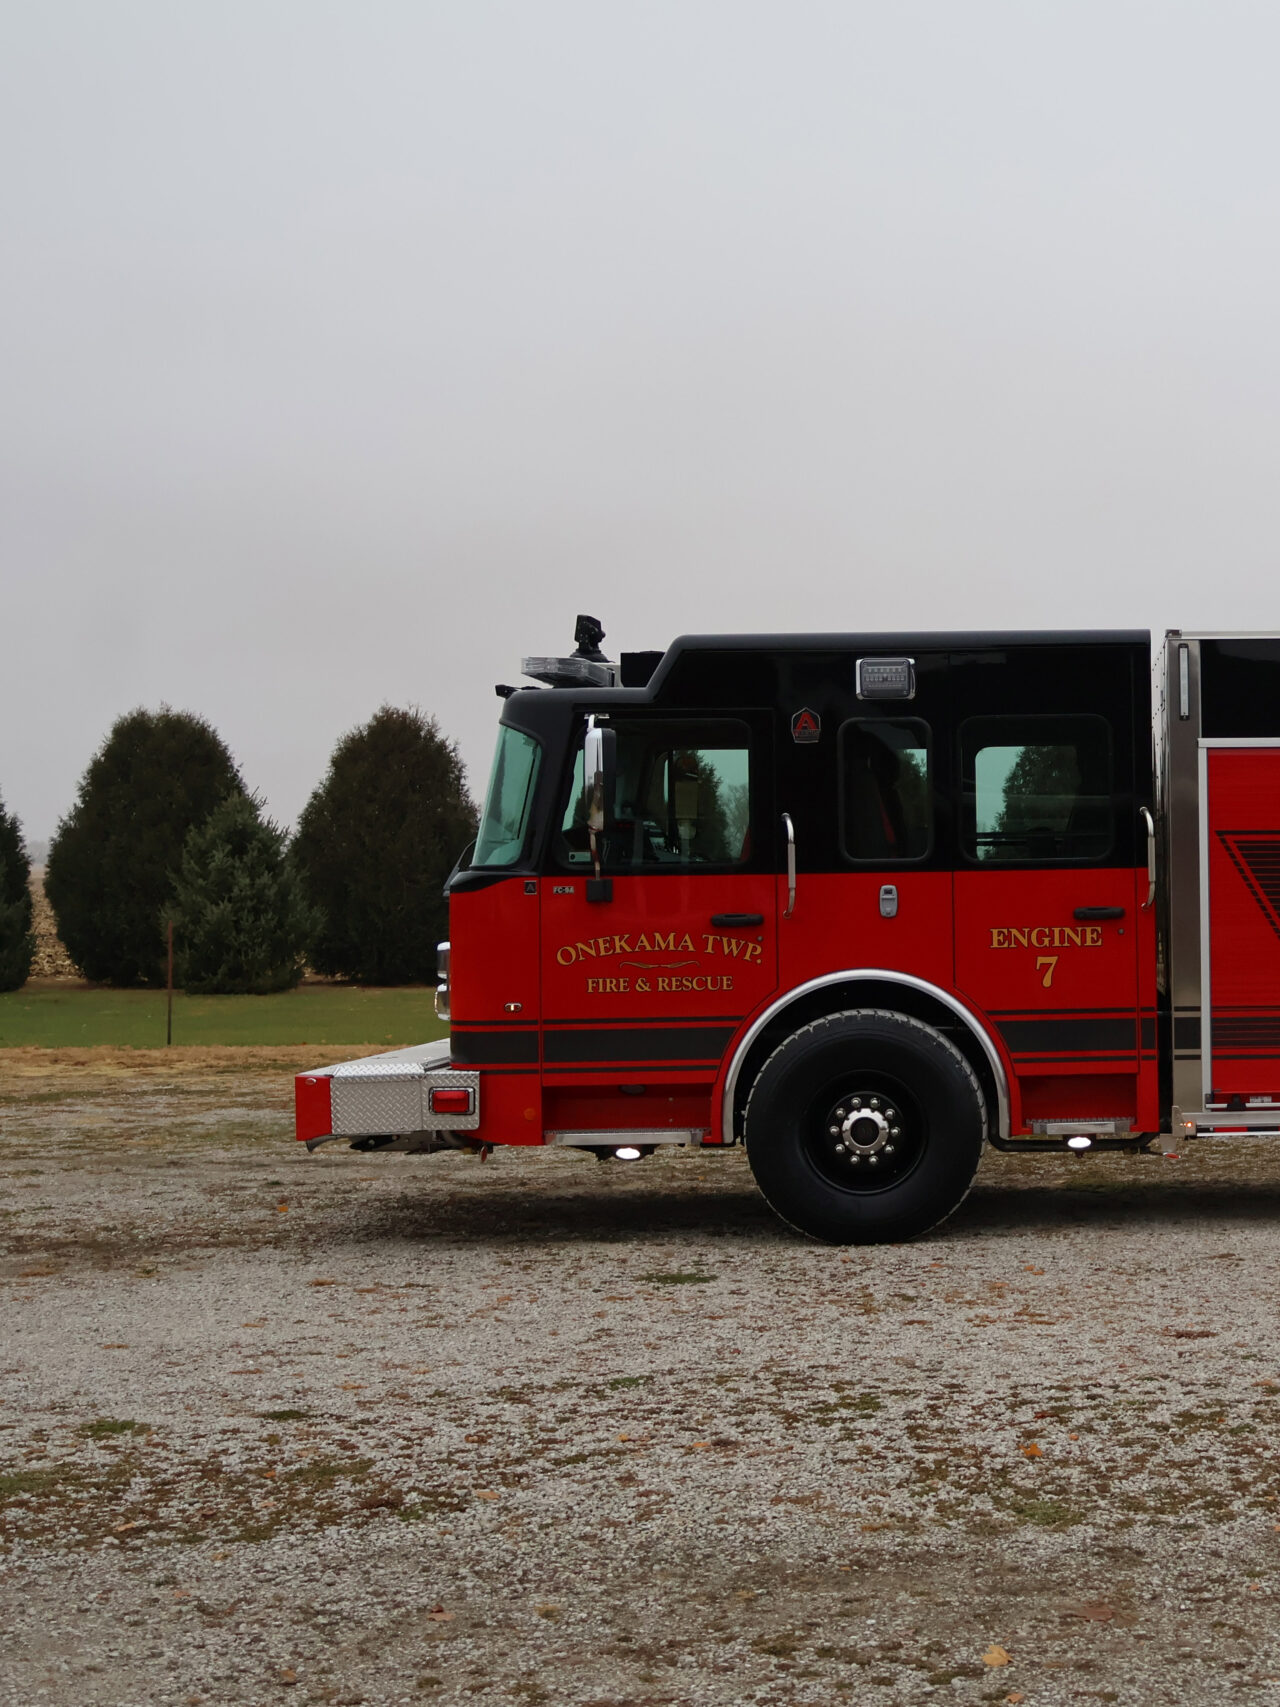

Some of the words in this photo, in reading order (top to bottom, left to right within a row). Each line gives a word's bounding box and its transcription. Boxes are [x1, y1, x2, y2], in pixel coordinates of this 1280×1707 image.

[556, 932, 696, 966] ONEKAMA
[702, 934, 763, 964] TWP.
[989, 926, 1103, 948] ENGINE
[586, 977, 630, 993] FIRE
[635, 977, 652, 992] &
[656, 975, 734, 992] RESCUE
[1035, 955, 1059, 988] 7
